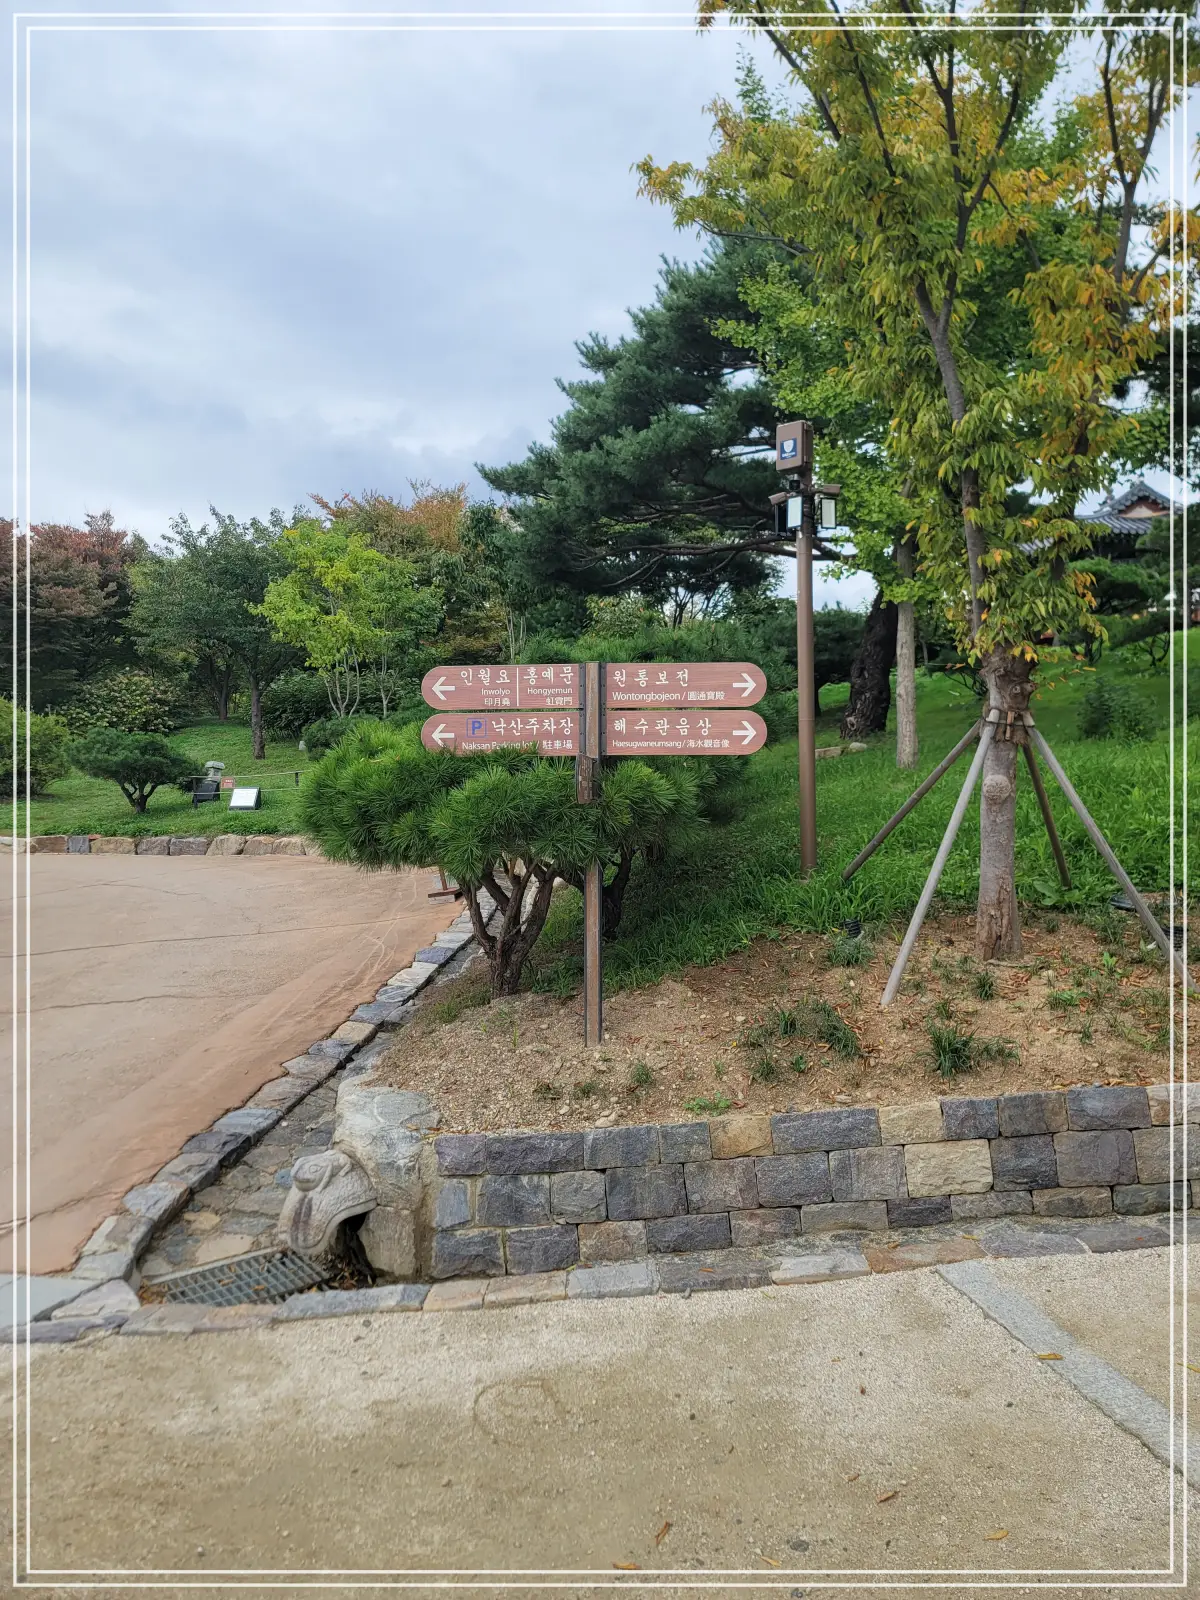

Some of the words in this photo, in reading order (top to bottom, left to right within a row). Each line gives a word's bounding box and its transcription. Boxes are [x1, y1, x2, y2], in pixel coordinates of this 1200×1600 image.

[460, 667, 511, 686] 인월요
[523, 666, 574, 686] 홍예문
[481, 688, 511, 697] Inwolyo
[527, 687, 573, 697] Hongyemun
[612, 691, 681, 703] Wontongbojeon
[491, 717, 574, 737] 낙산주차장
[462, 741, 491, 750] Naksan
[612, 739, 682, 749] Haesugwaneumsang
